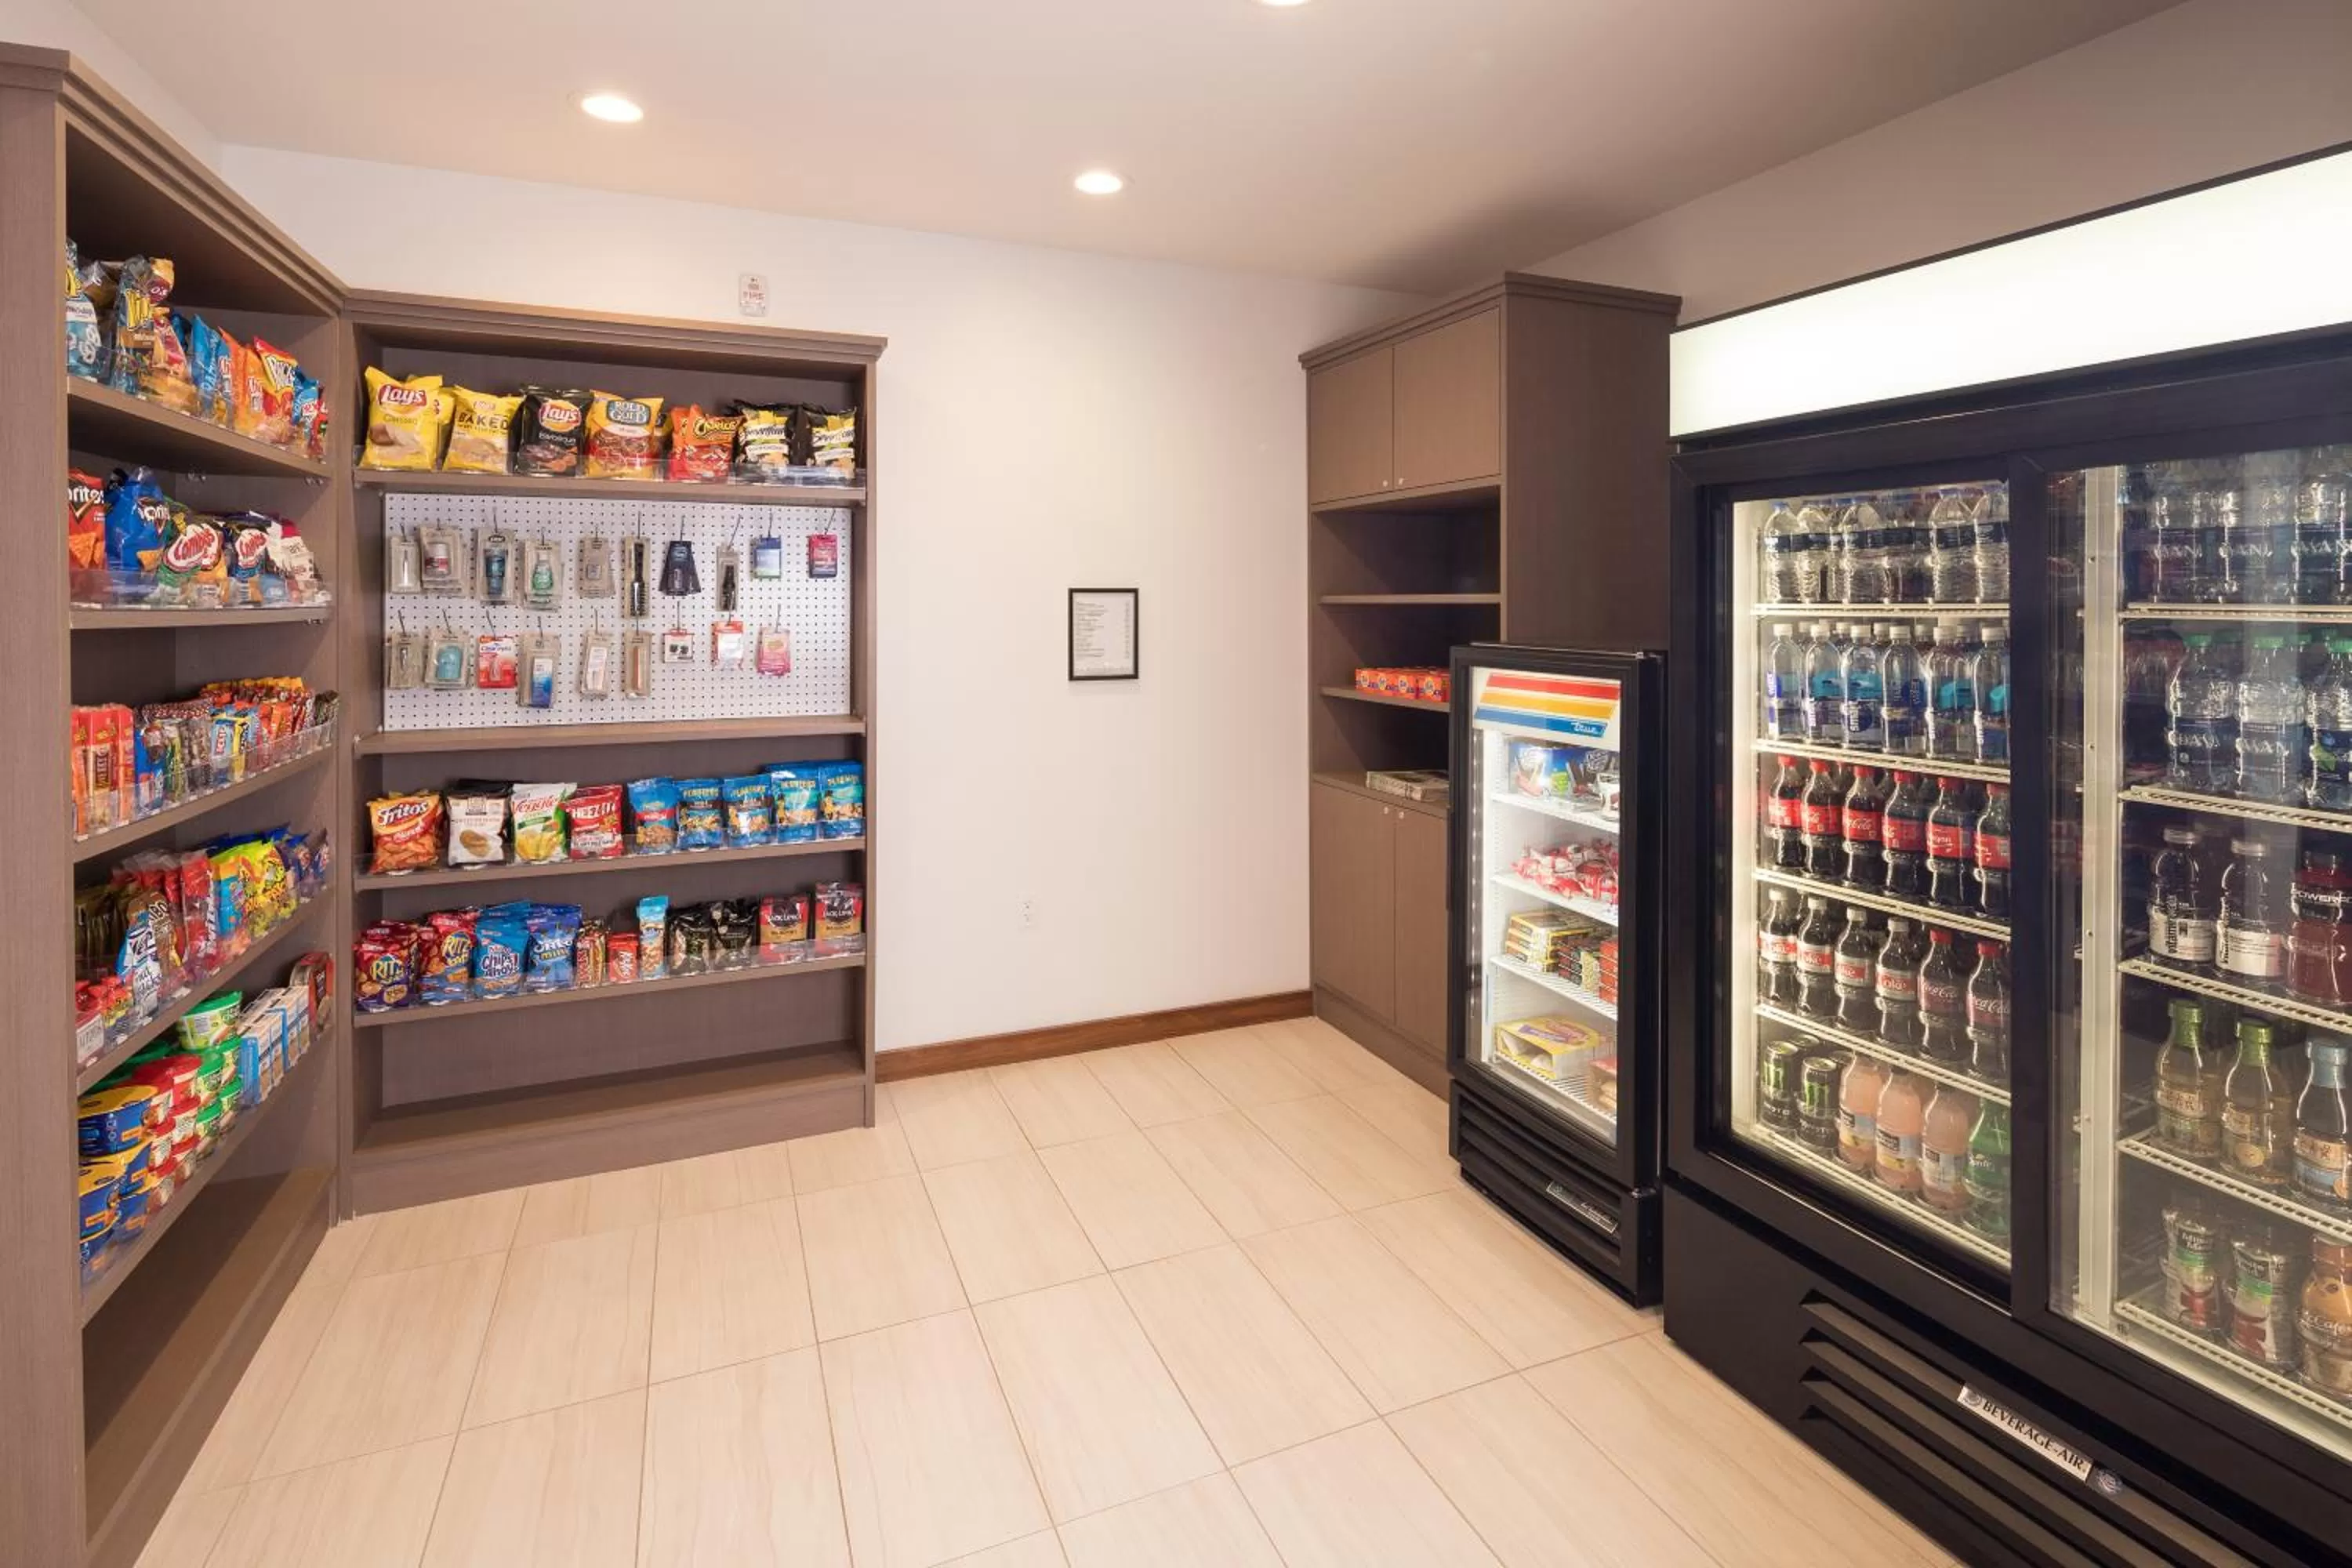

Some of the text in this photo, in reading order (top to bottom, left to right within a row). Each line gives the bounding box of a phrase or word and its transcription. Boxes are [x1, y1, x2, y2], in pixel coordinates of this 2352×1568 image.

[457, 412, 510, 430] BAKED
[376, 800, 427, 826] Fritos
[1982, 1399, 2084, 1471] BEVERAGE-AIR
